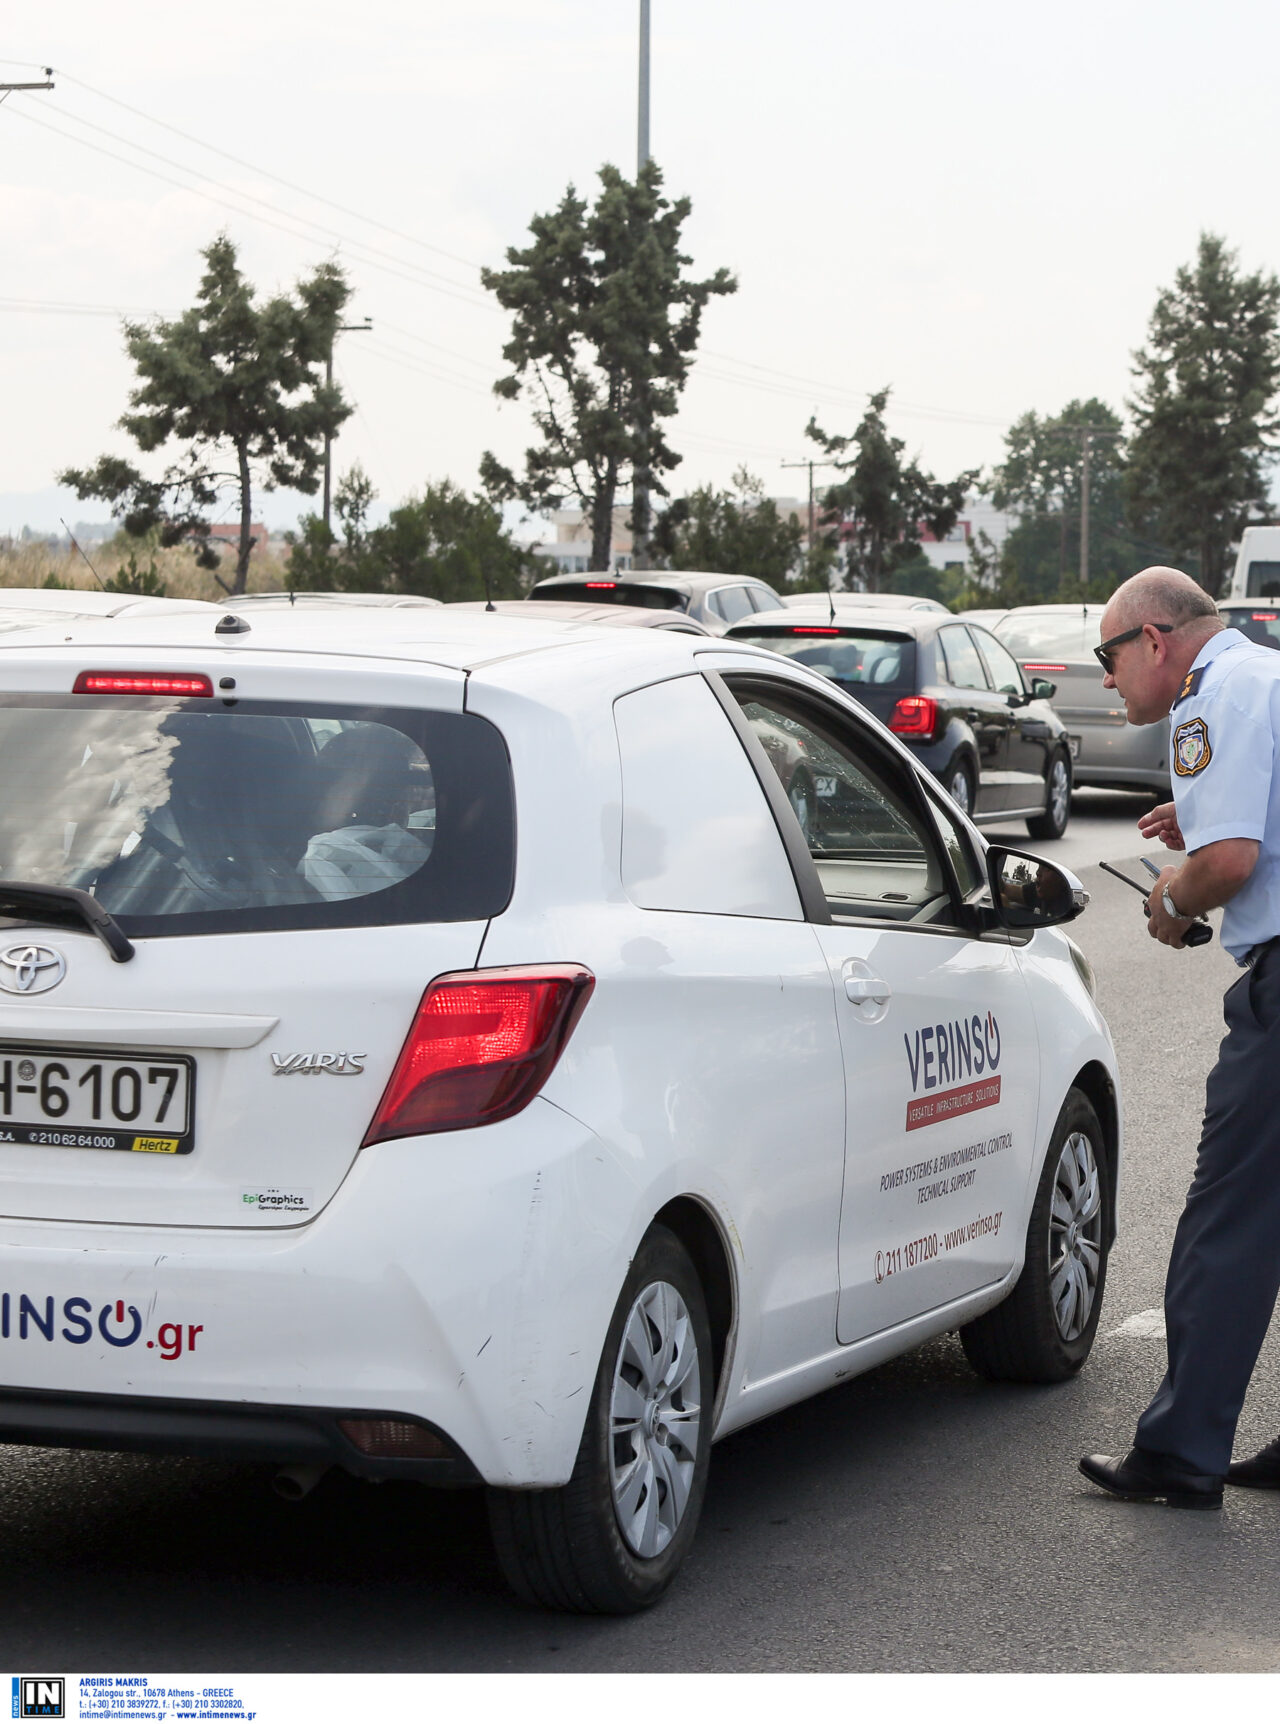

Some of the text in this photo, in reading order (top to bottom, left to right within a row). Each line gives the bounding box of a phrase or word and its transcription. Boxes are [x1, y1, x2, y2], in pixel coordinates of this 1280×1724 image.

[904, 1010, 1001, 1093] VERINSO
[909, 1083, 999, 1122] VERSATILE INFRASTRUCTURE SOLUTIONS
[139, 1140, 172, 1152] Hertz
[880, 1132, 1013, 1192] POWER SYSTEMS & ENVIRONMENTAL CONTROL
[243, 1194, 304, 1205] EpiGraphics
[917, 1169, 977, 1204] TECHNICAL SUPPORT
[886, 1247, 902, 1276] 211
[904, 1233, 938, 1268] 1877200
[944, 1211, 1003, 1251] www.verinso.gr
